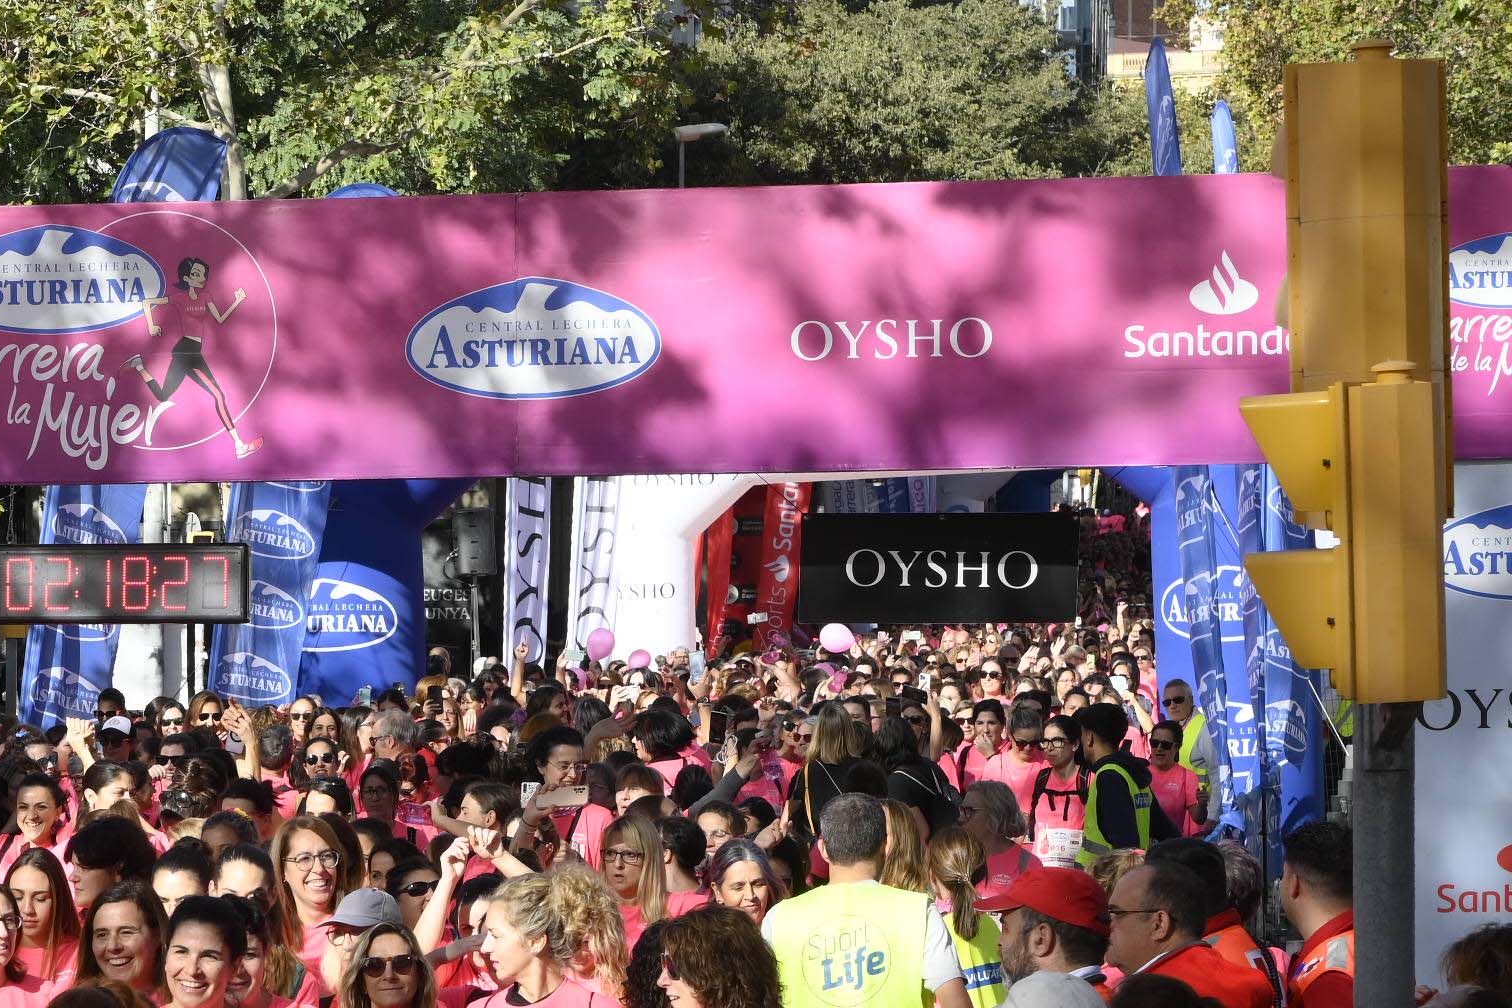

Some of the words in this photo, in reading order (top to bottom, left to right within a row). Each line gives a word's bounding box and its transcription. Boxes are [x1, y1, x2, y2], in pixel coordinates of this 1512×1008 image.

[70, 260, 140, 273] LECHERA
[1465, 259, 1512, 268] CENTRA
[465, 318, 543, 332] CENTRAL
[550, 317, 633, 331] LECHERA
[790, 316, 993, 361] OYSHO
[425, 324, 642, 370] ASTURIANA
[1474, 343, 1492, 373] la
[5, 386, 31, 426] la
[26, 378, 175, 471] Mujer
[1471, 536, 1512, 547] CENT
[5, 555, 230, 612] 02:18:27
[514, 476, 546, 664] OYSH
[844, 548, 1039, 590] OYSHO
[307, 614, 389, 633] URIANA
[335, 603, 384, 612] LECHERA
[807, 921, 870, 961] Sport
[821, 945, 886, 991] Life
